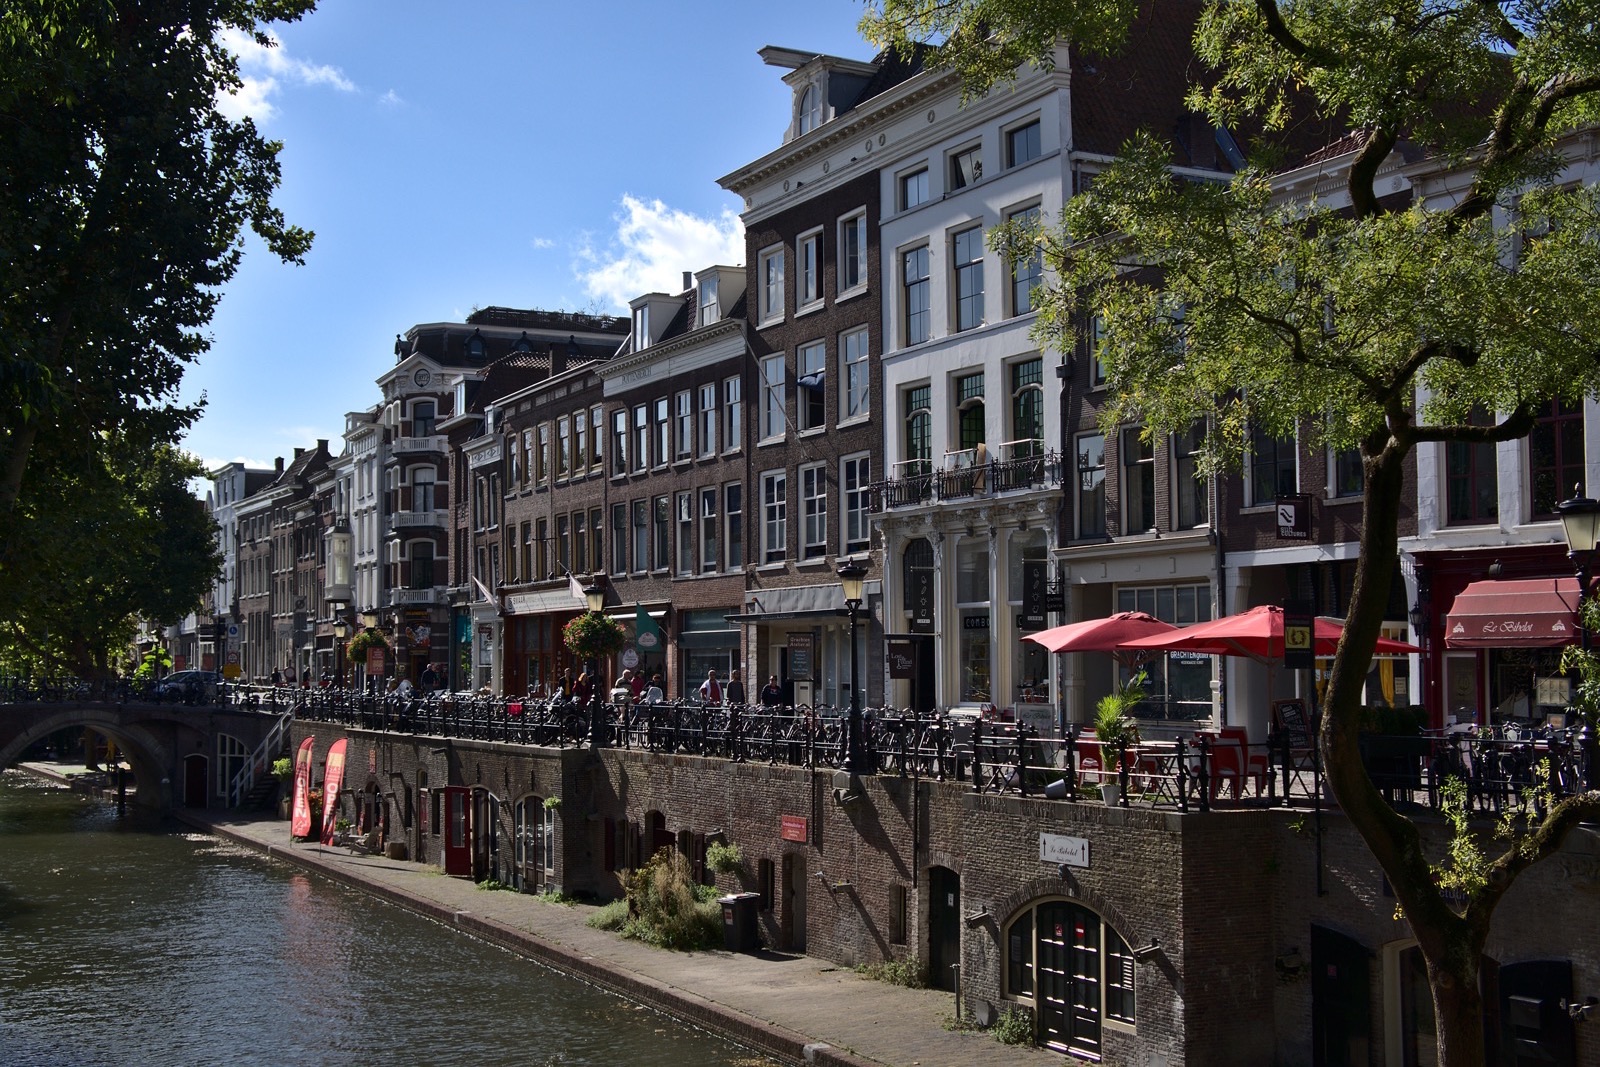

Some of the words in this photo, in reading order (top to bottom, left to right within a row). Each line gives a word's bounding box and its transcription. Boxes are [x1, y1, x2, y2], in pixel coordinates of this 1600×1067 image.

[1482, 622, 1498, 633] Le
[1500, 621, 1534, 633] Bibelot
[295, 777, 308, 818] OPEN
